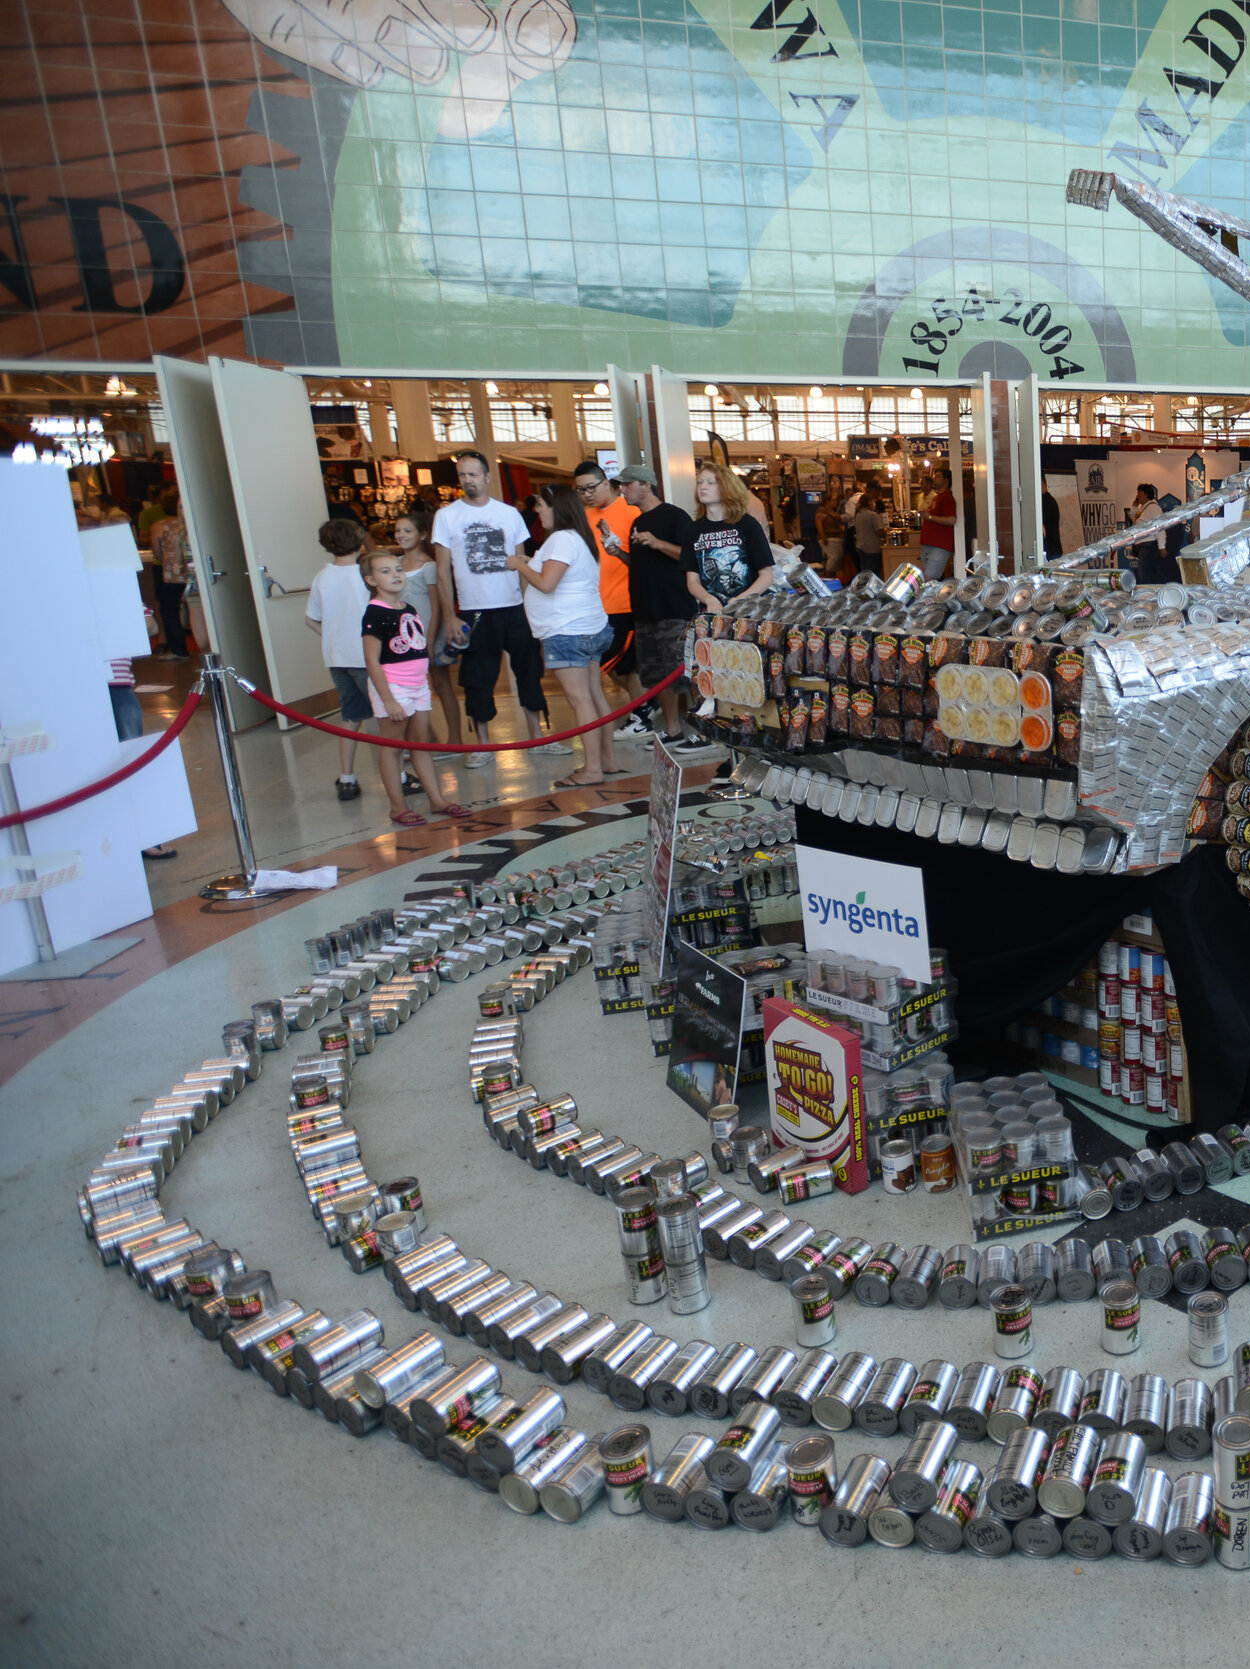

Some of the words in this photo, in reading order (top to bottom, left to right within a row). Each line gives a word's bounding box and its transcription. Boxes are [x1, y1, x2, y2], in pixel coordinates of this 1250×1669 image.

[902, 283, 1084, 382] 1854-2004
[693, 537, 742, 551] SEVENFOLD
[698, 529, 739, 542] AVENGED
[682, 914, 694, 922] LE
[698, 907, 737, 920] SUEUR
[807, 892, 920, 938] syngenta
[607, 968, 620, 976] LE
[615, 1002, 628, 1010] LE
[661, 1005, 675, 1015] LE
[817, 993, 842, 1008] SUEUR
[900, 1005, 913, 1017] LE
[914, 988, 947, 1012] SUEUR
[774, 1044, 820, 1069] HOMEMADE
[901, 1051, 914, 1063] LE
[914, 1033, 948, 1057] SUEUR
[778, 1062, 801, 1091] TO
[805, 1068, 833, 1099] GO!
[803, 1094, 835, 1129] PIZZA
[852, 1087, 861, 1118] CHEESE
[853, 1119, 862, 1139] REAL
[880, 1118, 897, 1129] LE
[899, 1107, 946, 1125] SUEUR
[855, 1140, 864, 1162] 100%
[991, 1175, 1008, 1187] LE
[1011, 1165, 1062, 1183] SUEUR
[995, 1222, 1012, 1233] LE
[1015, 1211, 1063, 1229] SUEUR
[608, 1458, 644, 1473] SUEUR
[1239, 1456, 1250, 1464] LE
